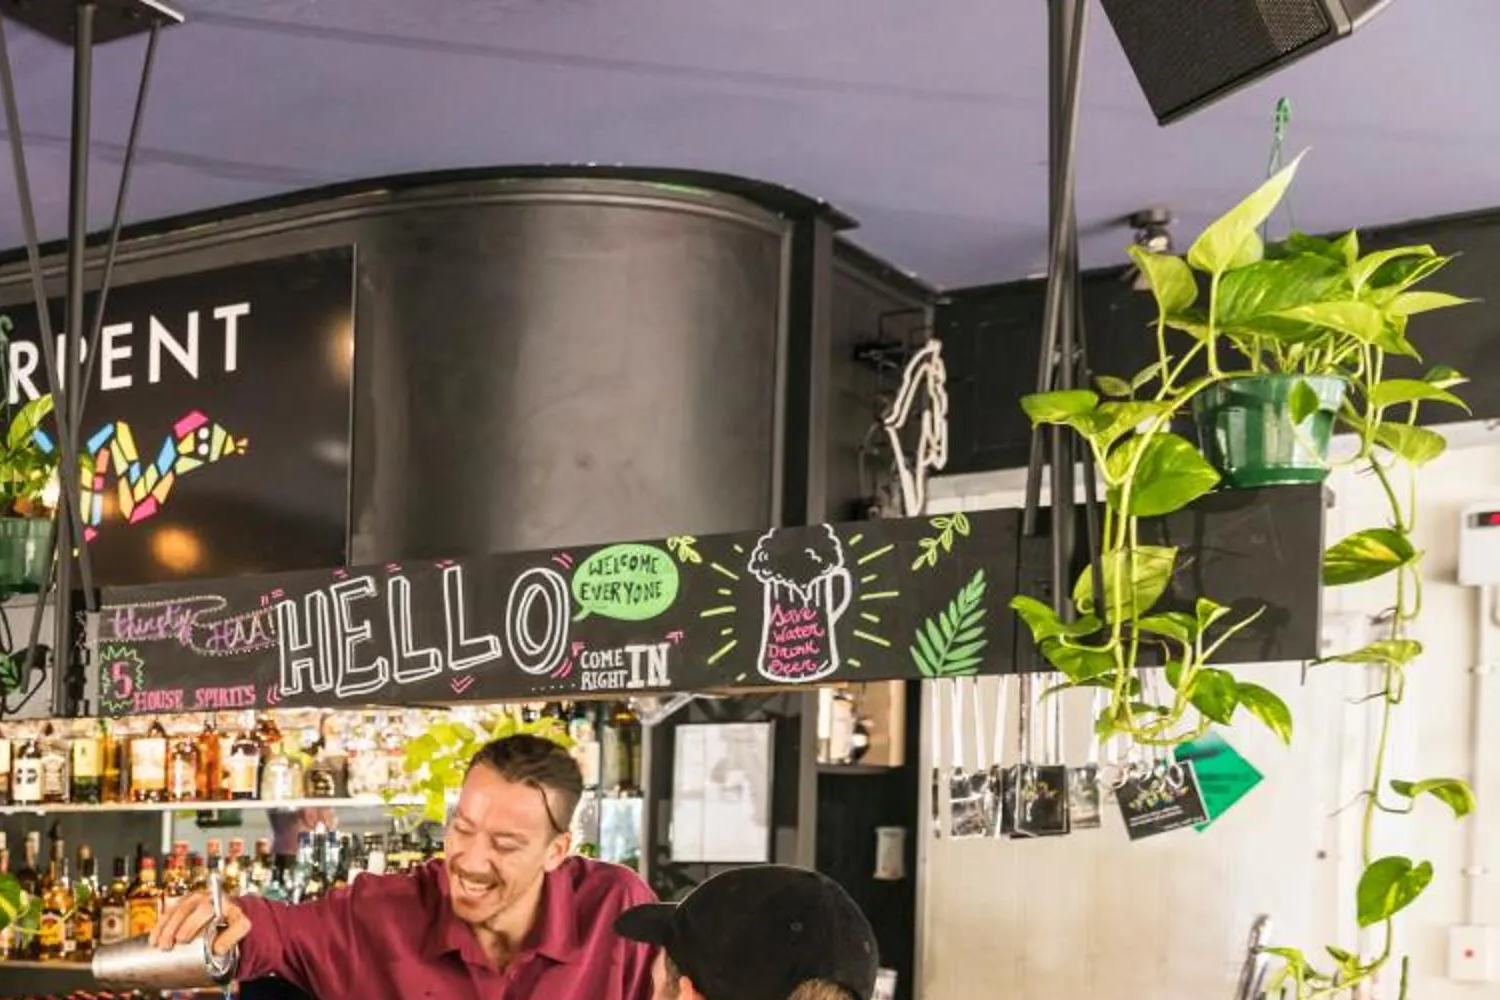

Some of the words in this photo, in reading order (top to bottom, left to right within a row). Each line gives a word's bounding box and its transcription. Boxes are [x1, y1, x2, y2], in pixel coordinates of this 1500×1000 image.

[588, 554, 660, 576] WELCOME
[580, 581, 664, 605] EVERYONE
[276, 564, 569, 698] HELLO
[580, 648, 625, 669] COME
[624, 642, 671, 689] IN
[580, 669, 628, 691] RIGHT
[132, 689, 184, 713] HOUSE
[195, 685, 257, 710] SPIRITS
